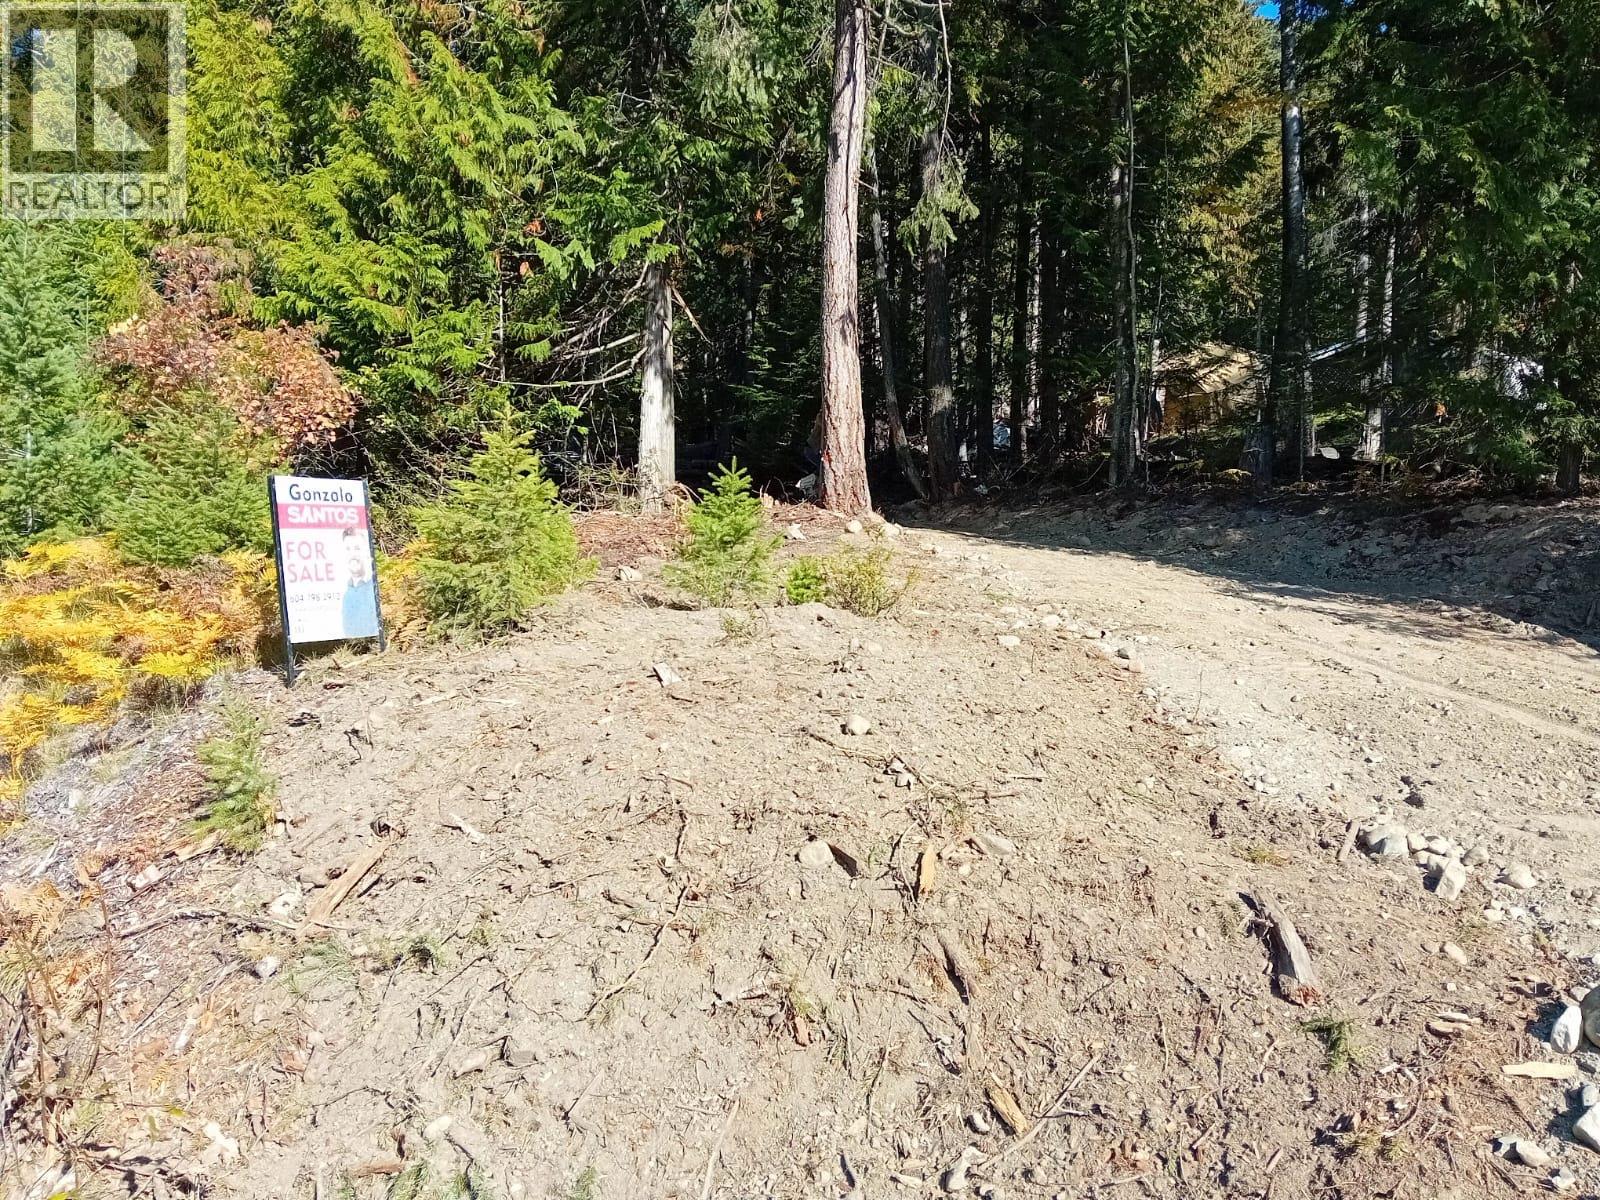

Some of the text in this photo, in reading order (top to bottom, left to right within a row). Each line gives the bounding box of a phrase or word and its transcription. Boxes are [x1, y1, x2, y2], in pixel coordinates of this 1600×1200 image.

[289, 483, 353, 503] Gonzalo
[287, 505, 360, 524] SANTOS
[285, 540, 326, 561] FOR
[286, 562, 336, 584] SALE
